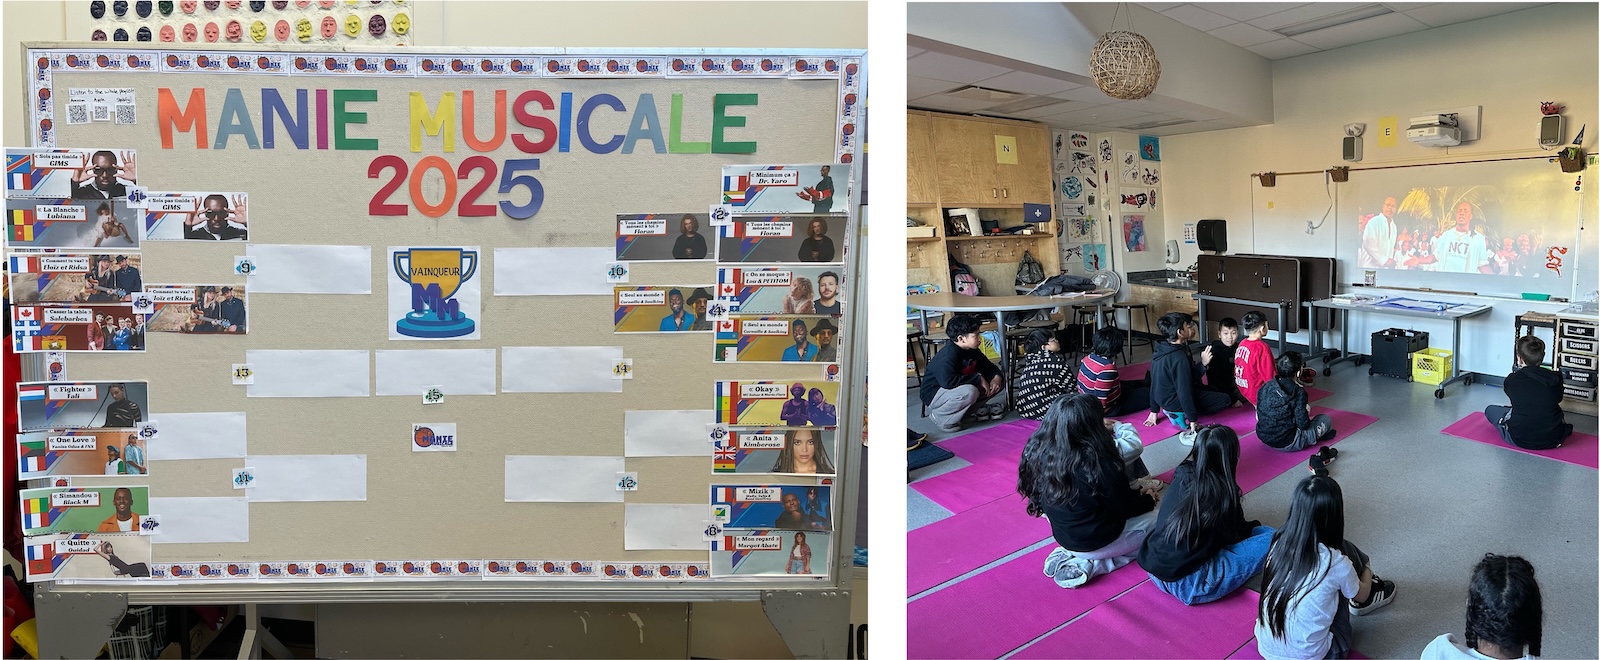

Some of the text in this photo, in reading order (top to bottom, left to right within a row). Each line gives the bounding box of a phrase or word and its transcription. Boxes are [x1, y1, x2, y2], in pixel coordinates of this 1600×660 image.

[157, 87, 759, 154] MANIE MUSICALE
[1386, 128, 1390, 136] E
[367, 154, 545, 220] 2025
[716, 210, 724, 220] 2
[241, 263, 250, 273] 9
[411, 267, 460, 277] VAINQUEUR
[611, 267, 624, 276] 10
[139, 298, 147, 308] 3
[714, 306, 722, 316] 4
[236, 368, 249, 377] 13
[616, 365, 628, 373] 14
[428, 391, 440, 400] 15
[144, 428, 152, 437] 5
[715, 429, 723, 439] 6
[239, 474, 248, 482] 11
[621, 479, 633, 488] 12
[146, 520, 153, 530] 7
[709, 526, 716, 536] 8
